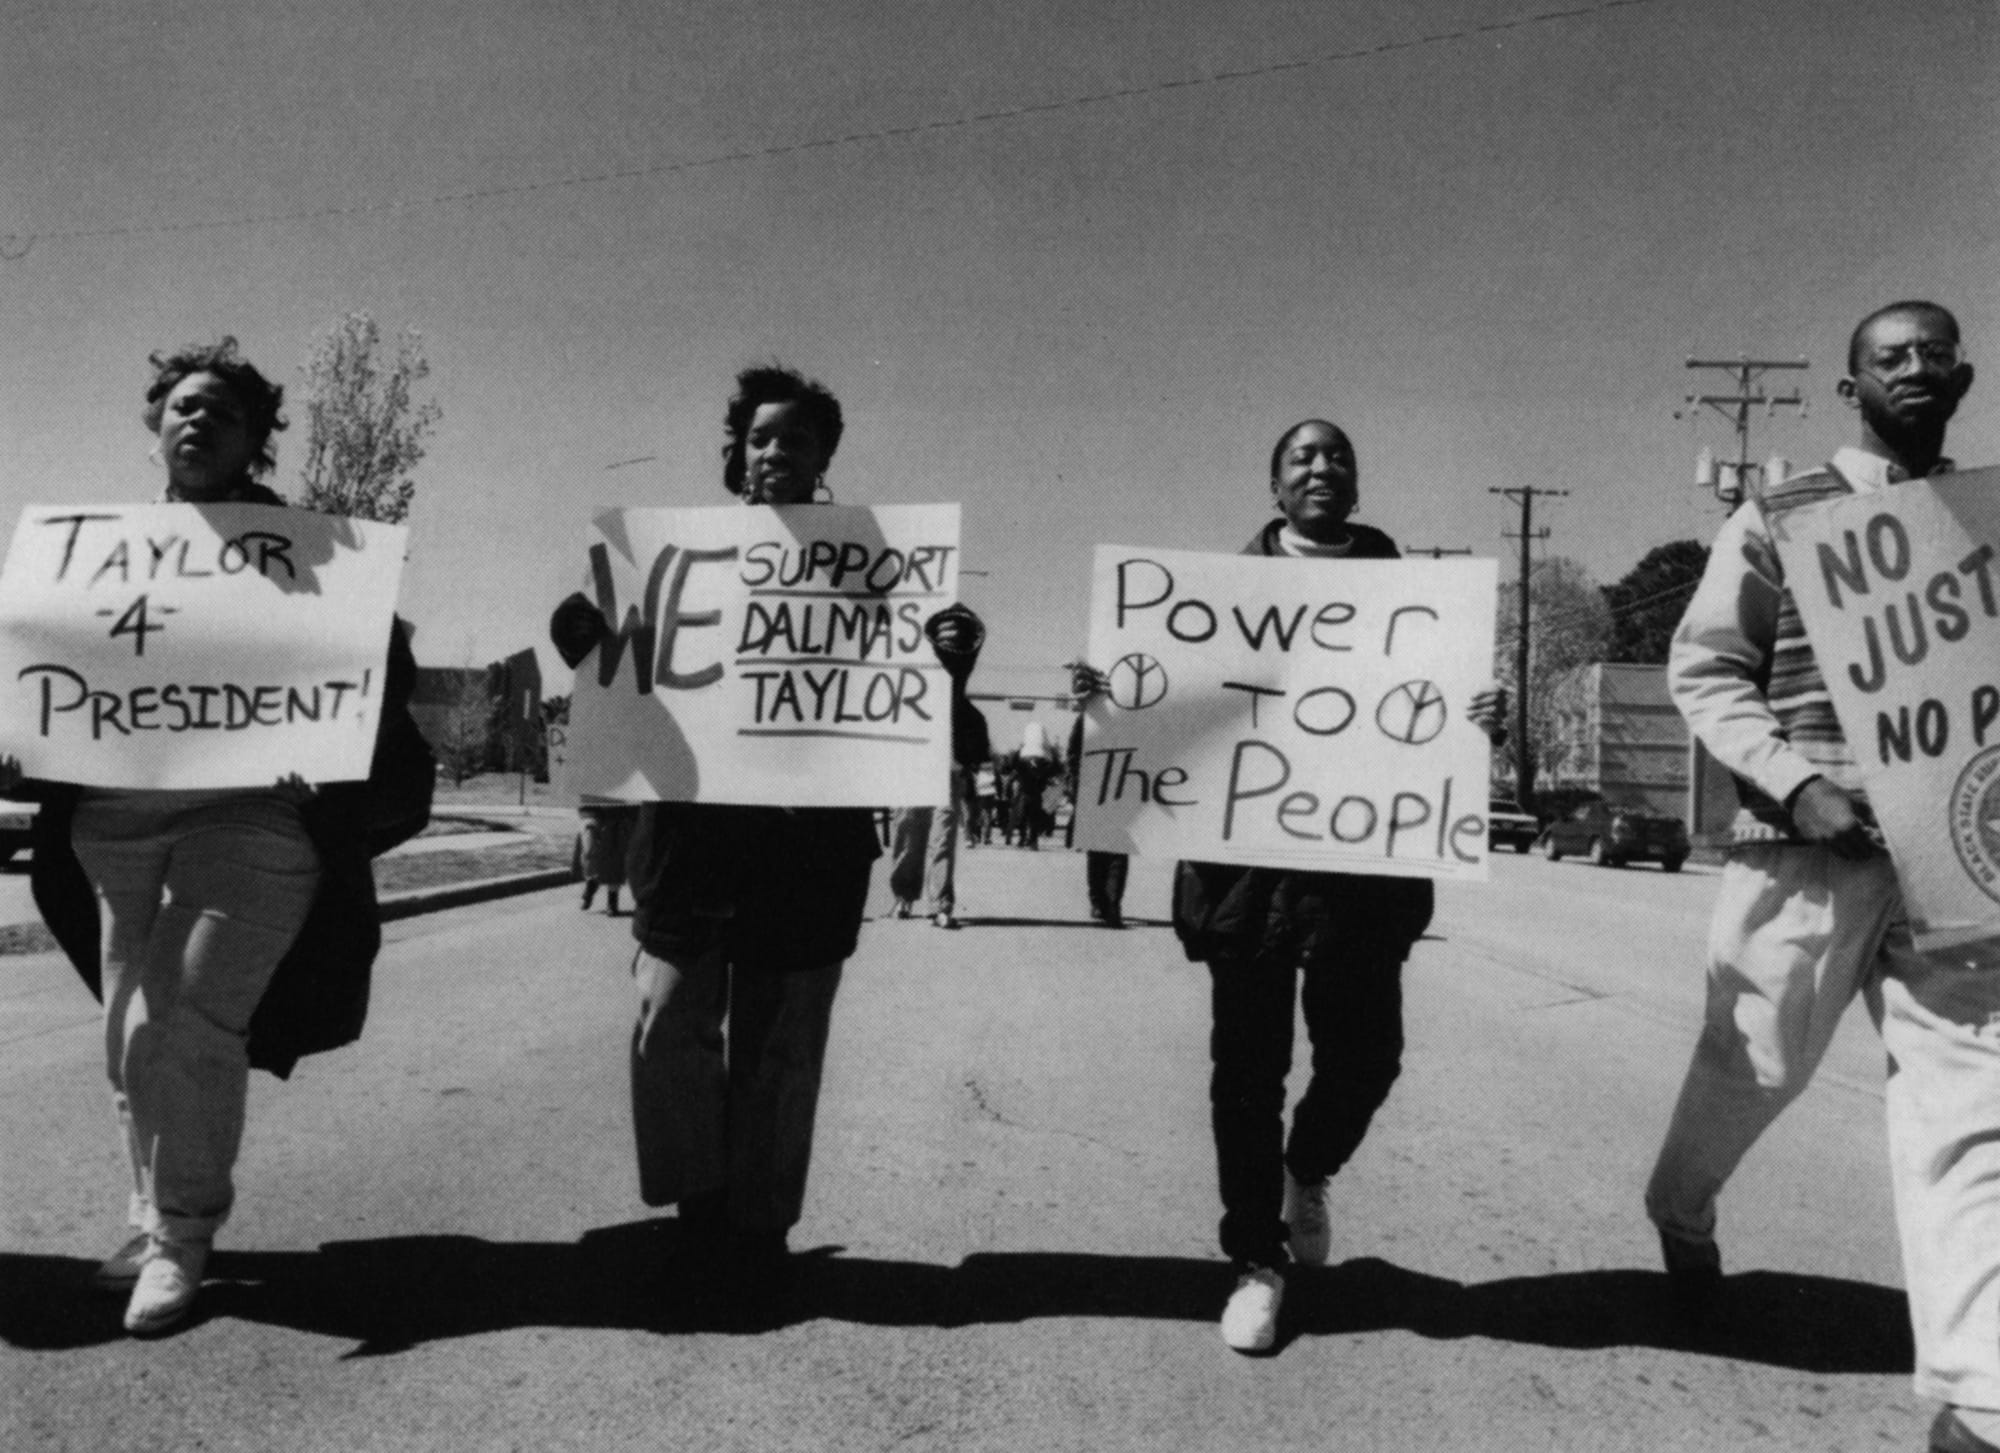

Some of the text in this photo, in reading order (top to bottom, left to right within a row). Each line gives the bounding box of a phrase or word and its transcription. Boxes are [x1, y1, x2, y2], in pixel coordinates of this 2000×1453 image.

[33, 513, 297, 590] TAYLOR
[740, 540, 957, 594] SUPPORT
[1816, 512, 1911, 610] NO
[589, 543, 739, 696] WE
[735, 602, 923, 660] DALMAS
[1117, 558, 1439, 656] Power
[1848, 543, 1999, 693] JUST
[17, 663, 372, 741] PRESIDENT!
[739, 668, 932, 723] TAYLOR
[1222, 681, 1356, 736] TO
[1877, 685, 2000, 765] NO P
[1085, 740, 1486, 864] The People
